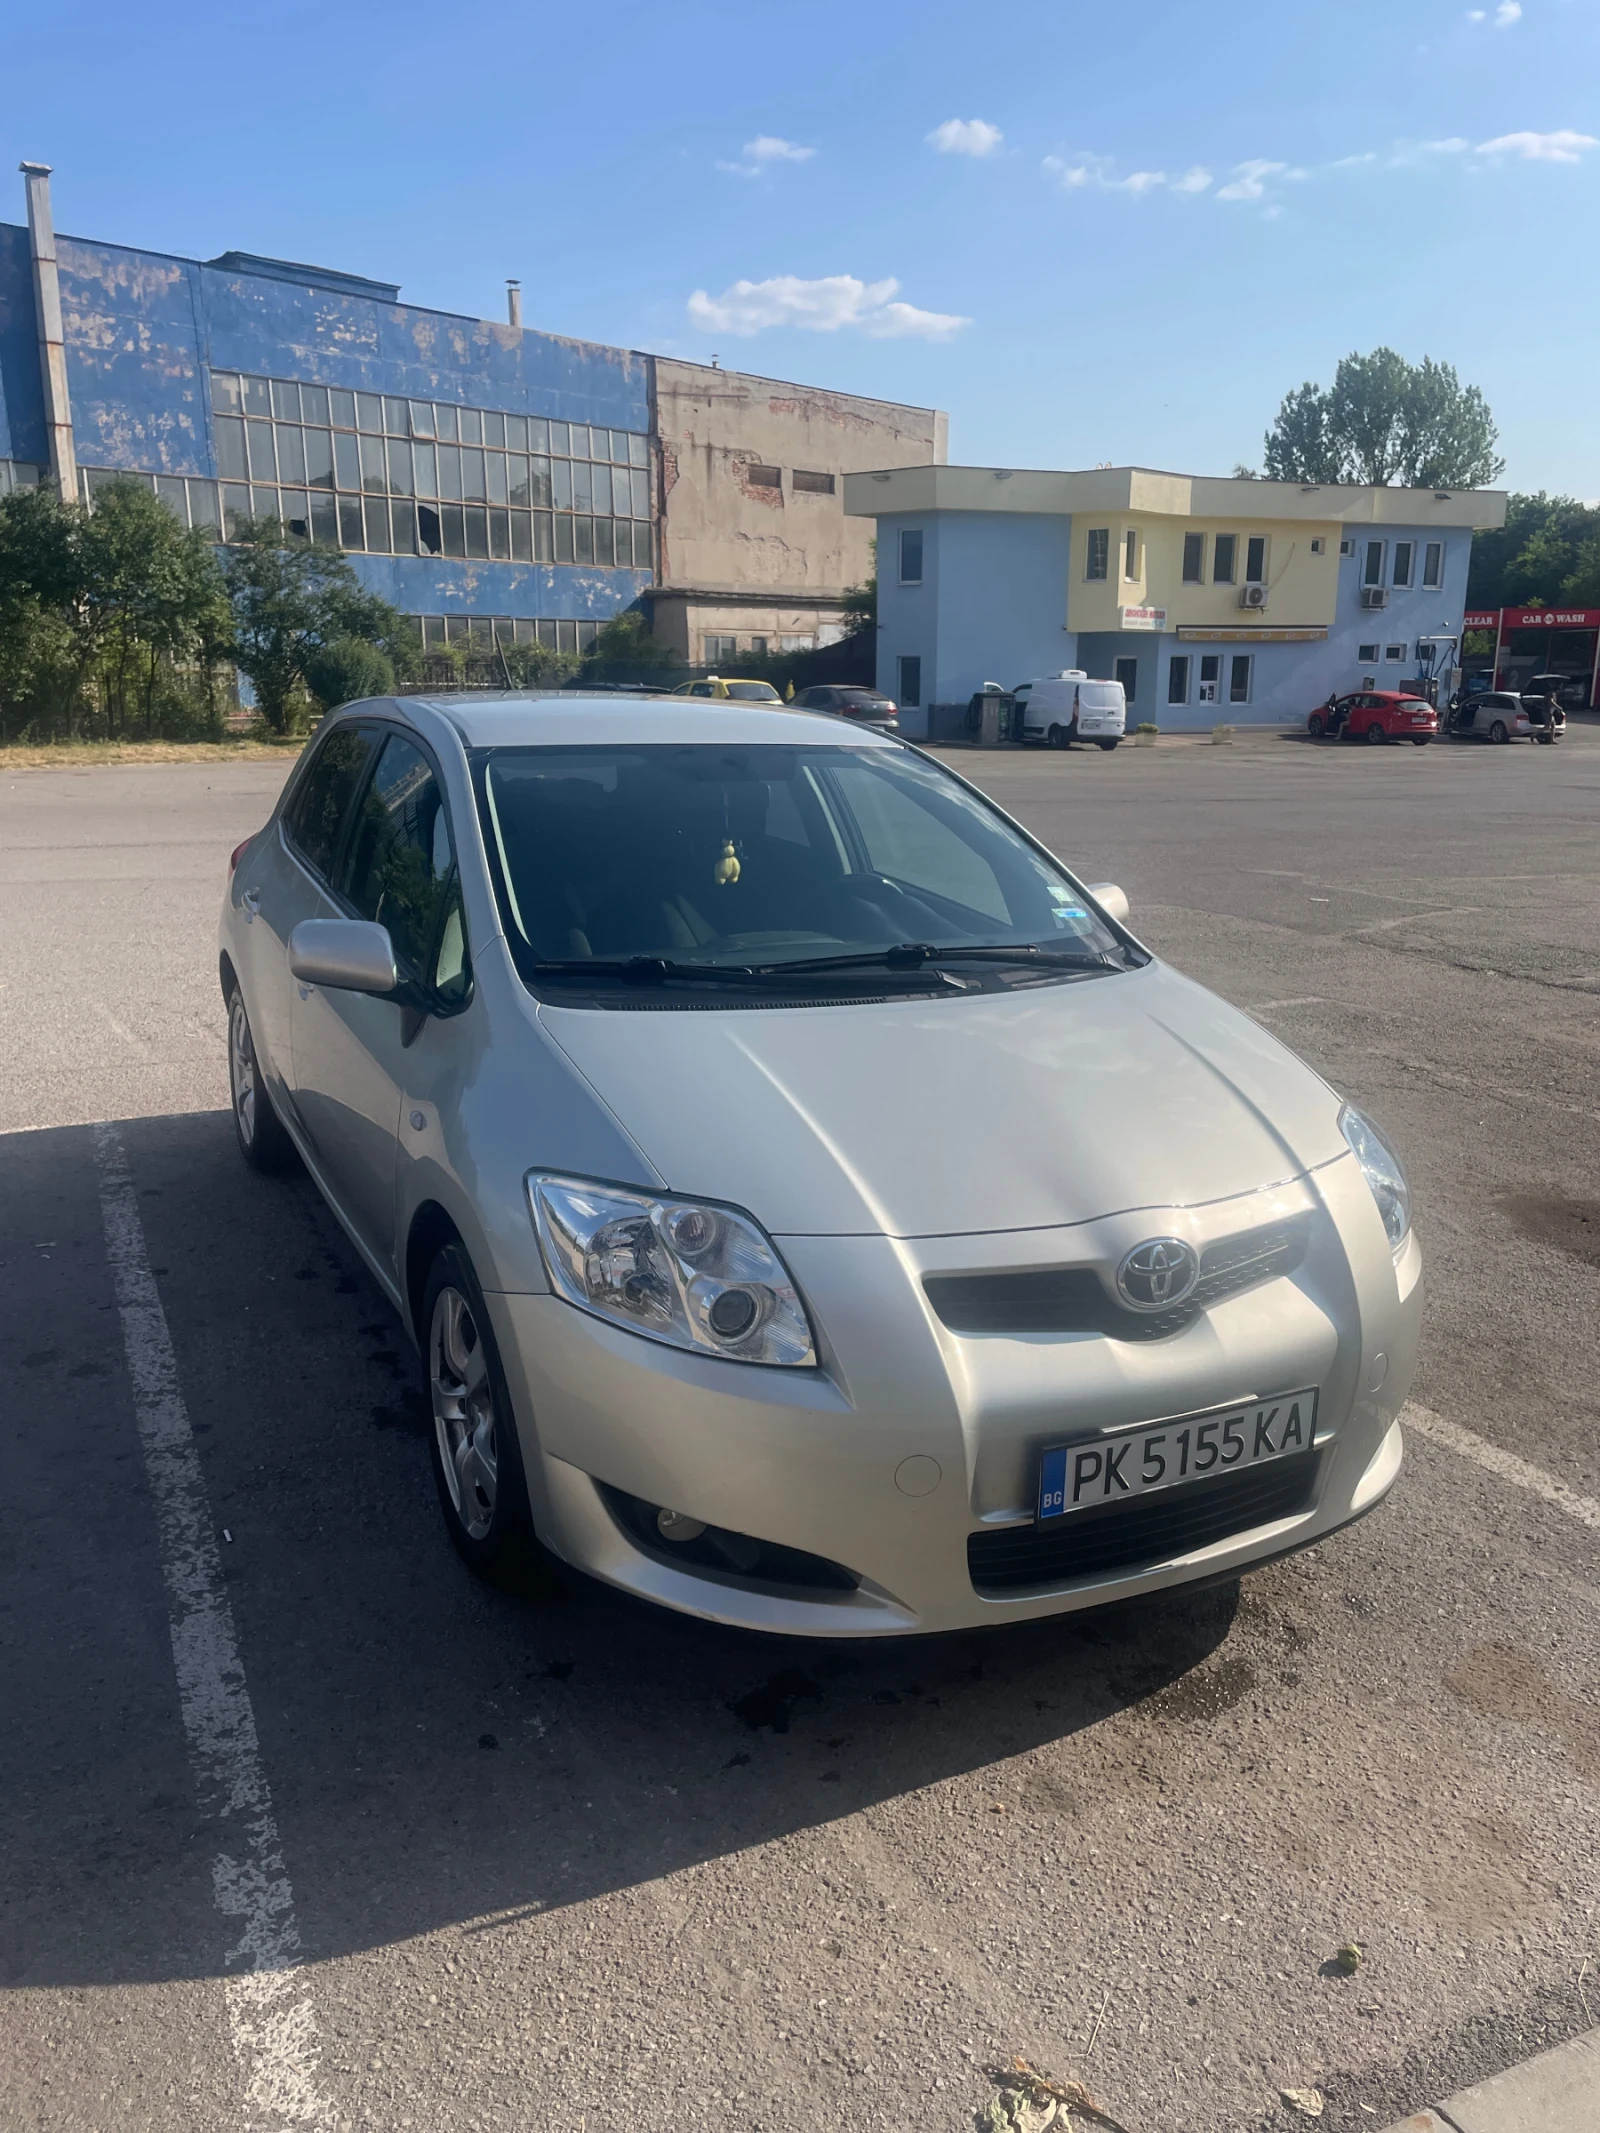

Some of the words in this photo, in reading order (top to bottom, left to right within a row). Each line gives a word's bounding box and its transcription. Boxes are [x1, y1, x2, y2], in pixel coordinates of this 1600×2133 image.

[1464, 616, 1493, 626] CLEAR
[1522, 615, 1542, 624] CAR
[1556, 613, 1586, 623] WASH
[1141, 1416, 1245, 1484] 5155
[1043, 1490, 1062, 1509] BG
